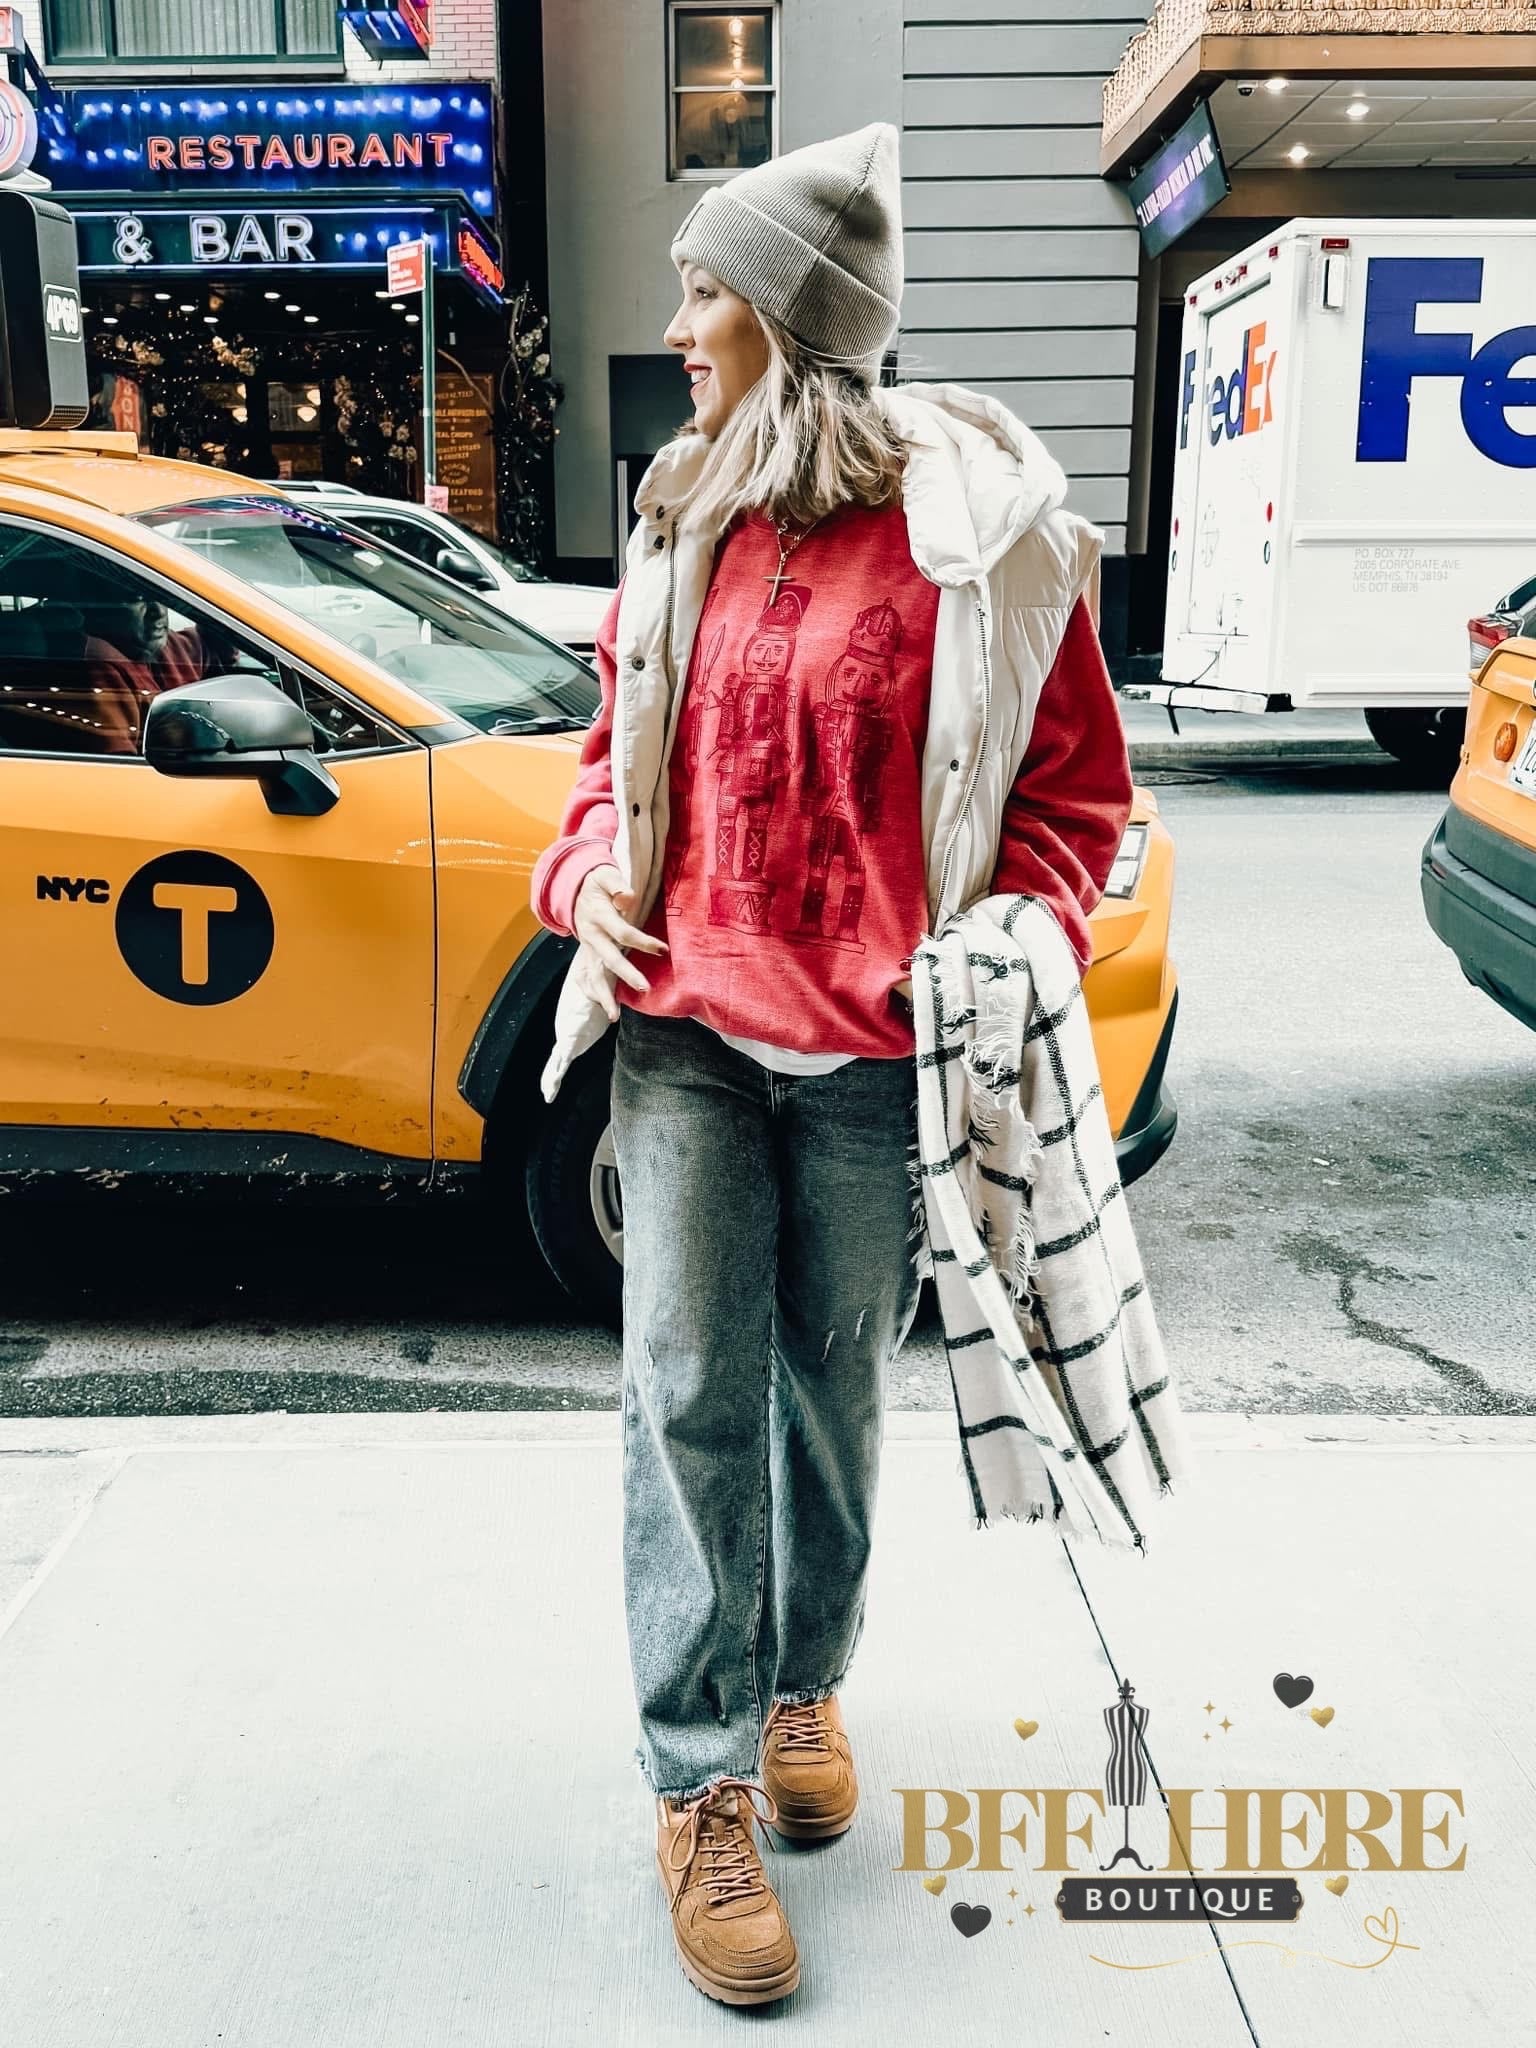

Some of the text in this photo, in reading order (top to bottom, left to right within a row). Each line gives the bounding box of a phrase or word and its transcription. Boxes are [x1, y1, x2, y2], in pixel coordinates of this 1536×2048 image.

[147, 132, 453, 171] RESTAURANT
[113, 214, 316, 264] & BAR
[1374, 547, 1395, 558] BOX
[1398, 547, 1415, 558] 727
[1379, 559, 1440, 570] CORPORATE
[1352, 582, 1366, 592] US
[1368, 582, 1389, 592] DOT
[36, 875, 238, 985] NYC T
